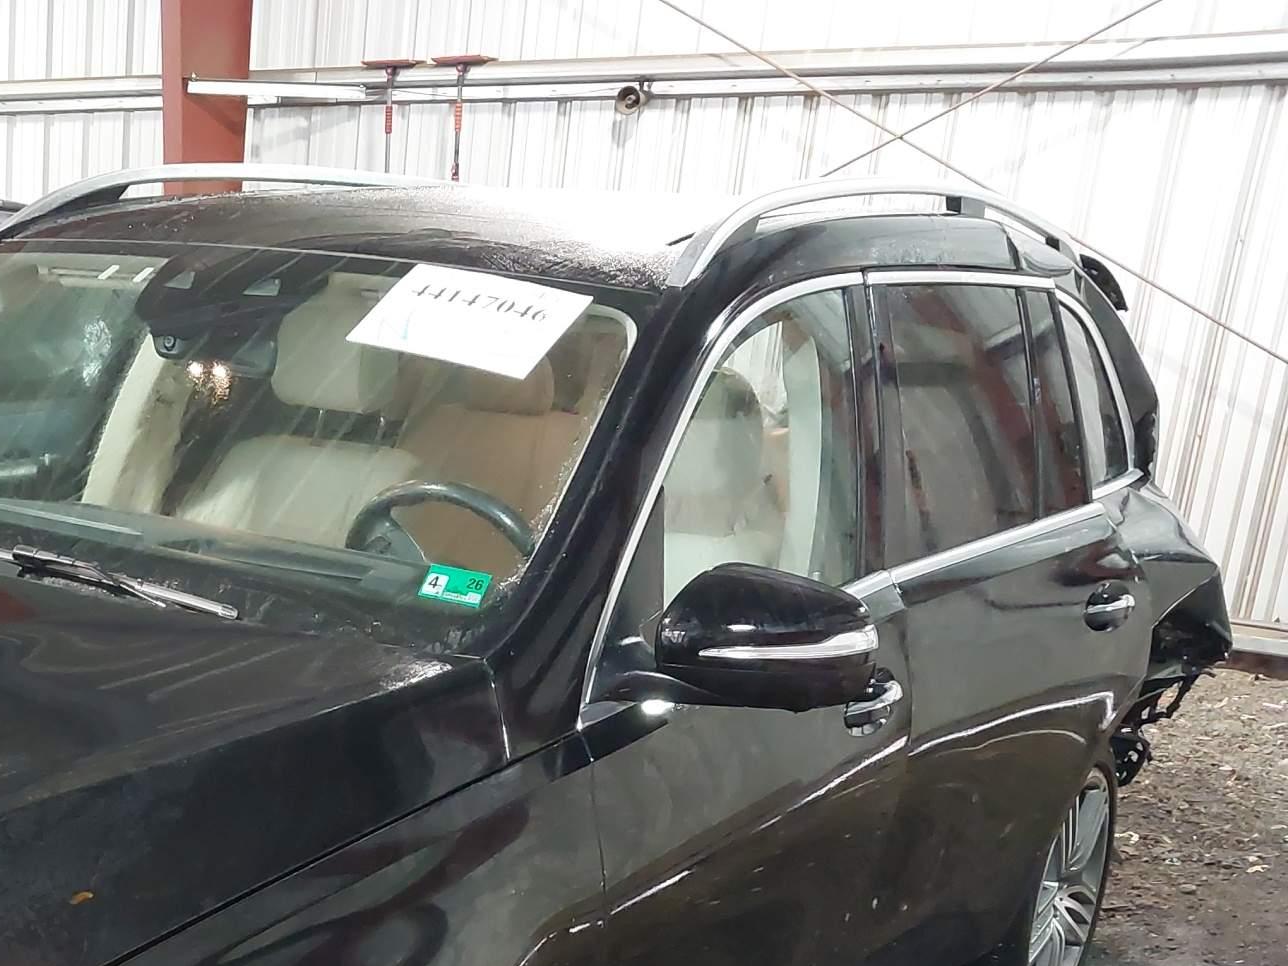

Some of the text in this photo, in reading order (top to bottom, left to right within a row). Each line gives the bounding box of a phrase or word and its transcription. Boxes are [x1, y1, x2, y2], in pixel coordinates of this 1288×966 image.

[411, 284, 547, 322] 44147046
[428, 576, 485, 591] 4 26
